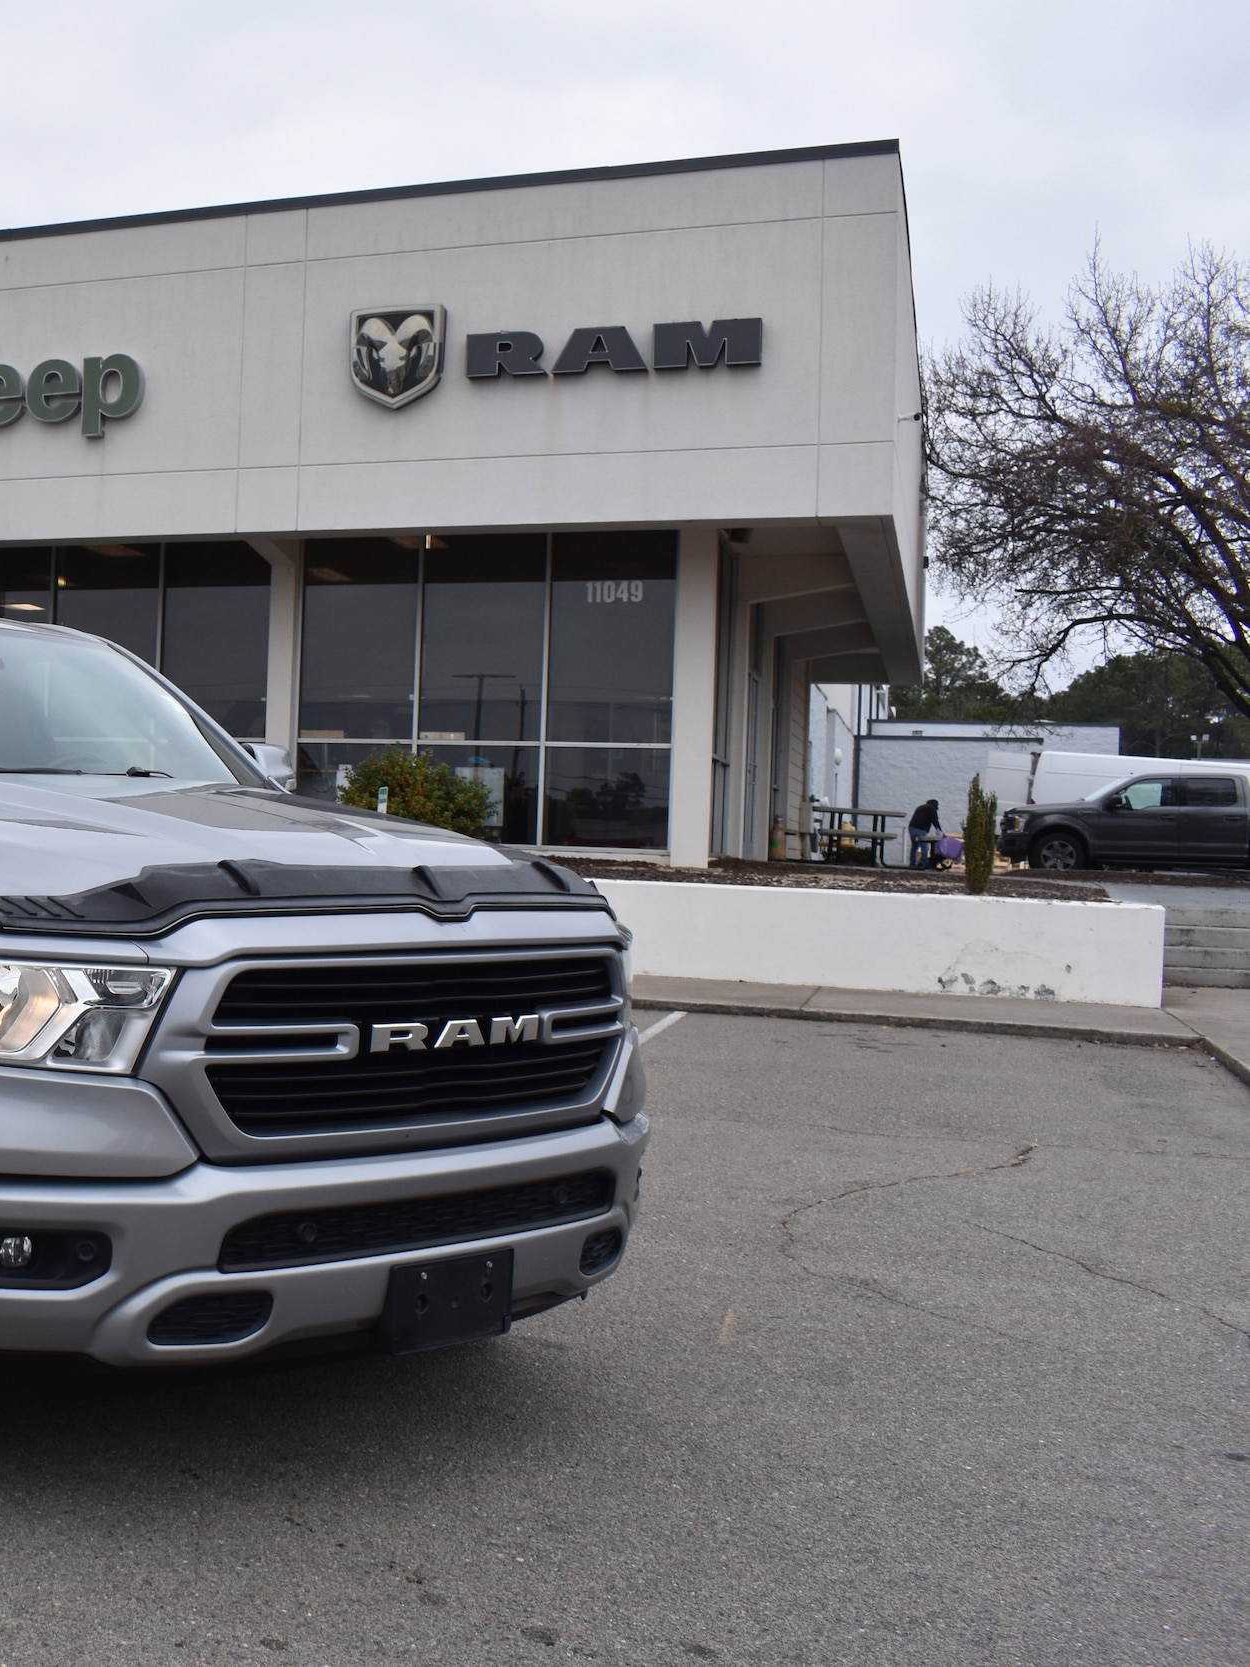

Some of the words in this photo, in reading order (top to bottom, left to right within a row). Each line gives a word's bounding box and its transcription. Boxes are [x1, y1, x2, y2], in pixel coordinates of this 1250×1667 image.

[466, 317, 763, 378] RAM
[585, 580, 644, 603] 11049
[369, 1013, 539, 1054] RAM
